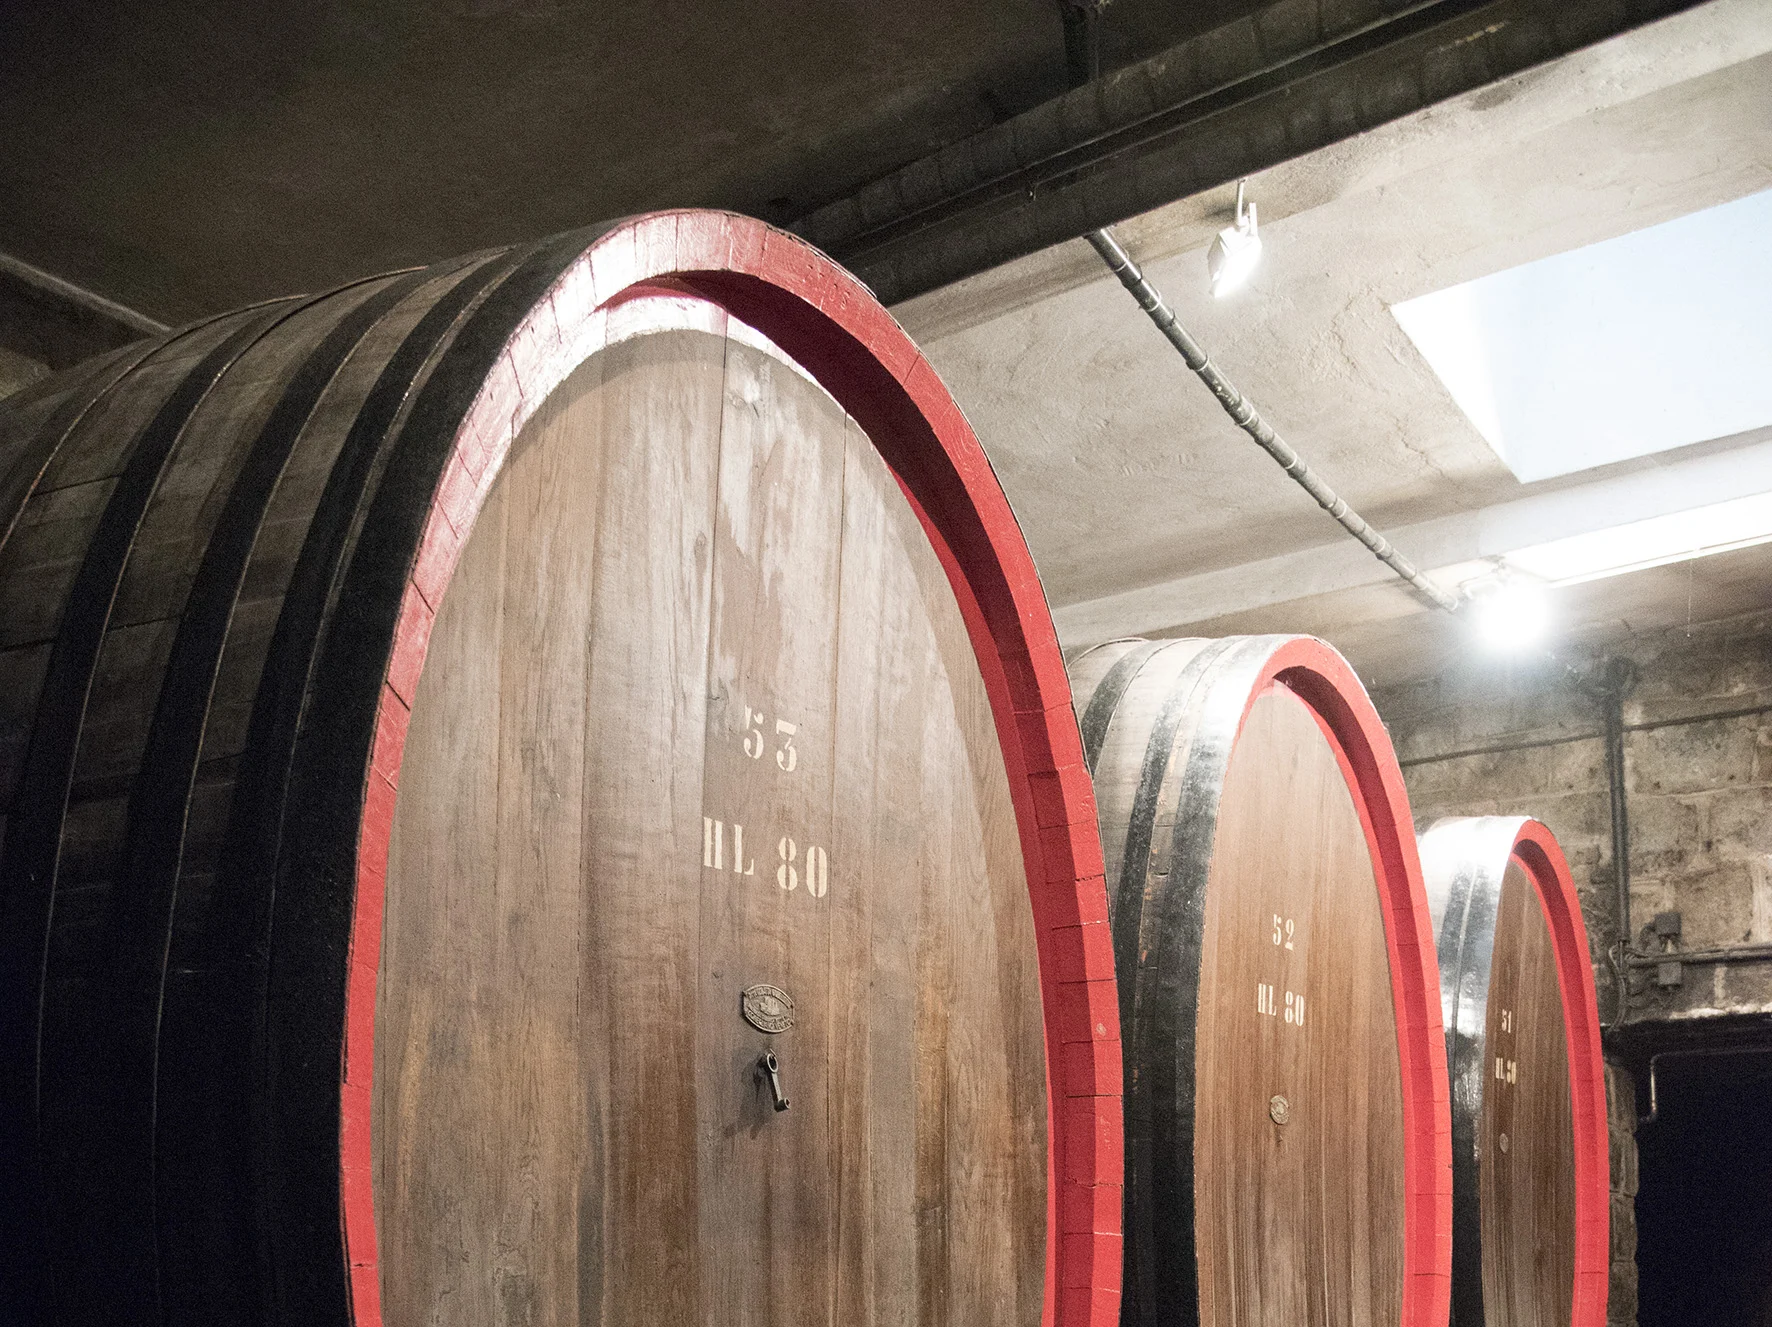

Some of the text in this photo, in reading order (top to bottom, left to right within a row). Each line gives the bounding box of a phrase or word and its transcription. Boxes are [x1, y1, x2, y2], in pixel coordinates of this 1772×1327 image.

[742, 704, 798, 772] 53
[702, 816, 828, 898] HL 80
[1272, 913, 1295, 951] 52
[1257, 982, 1305, 1027] HL 80
[1501, 1008, 1512, 1034] 51
